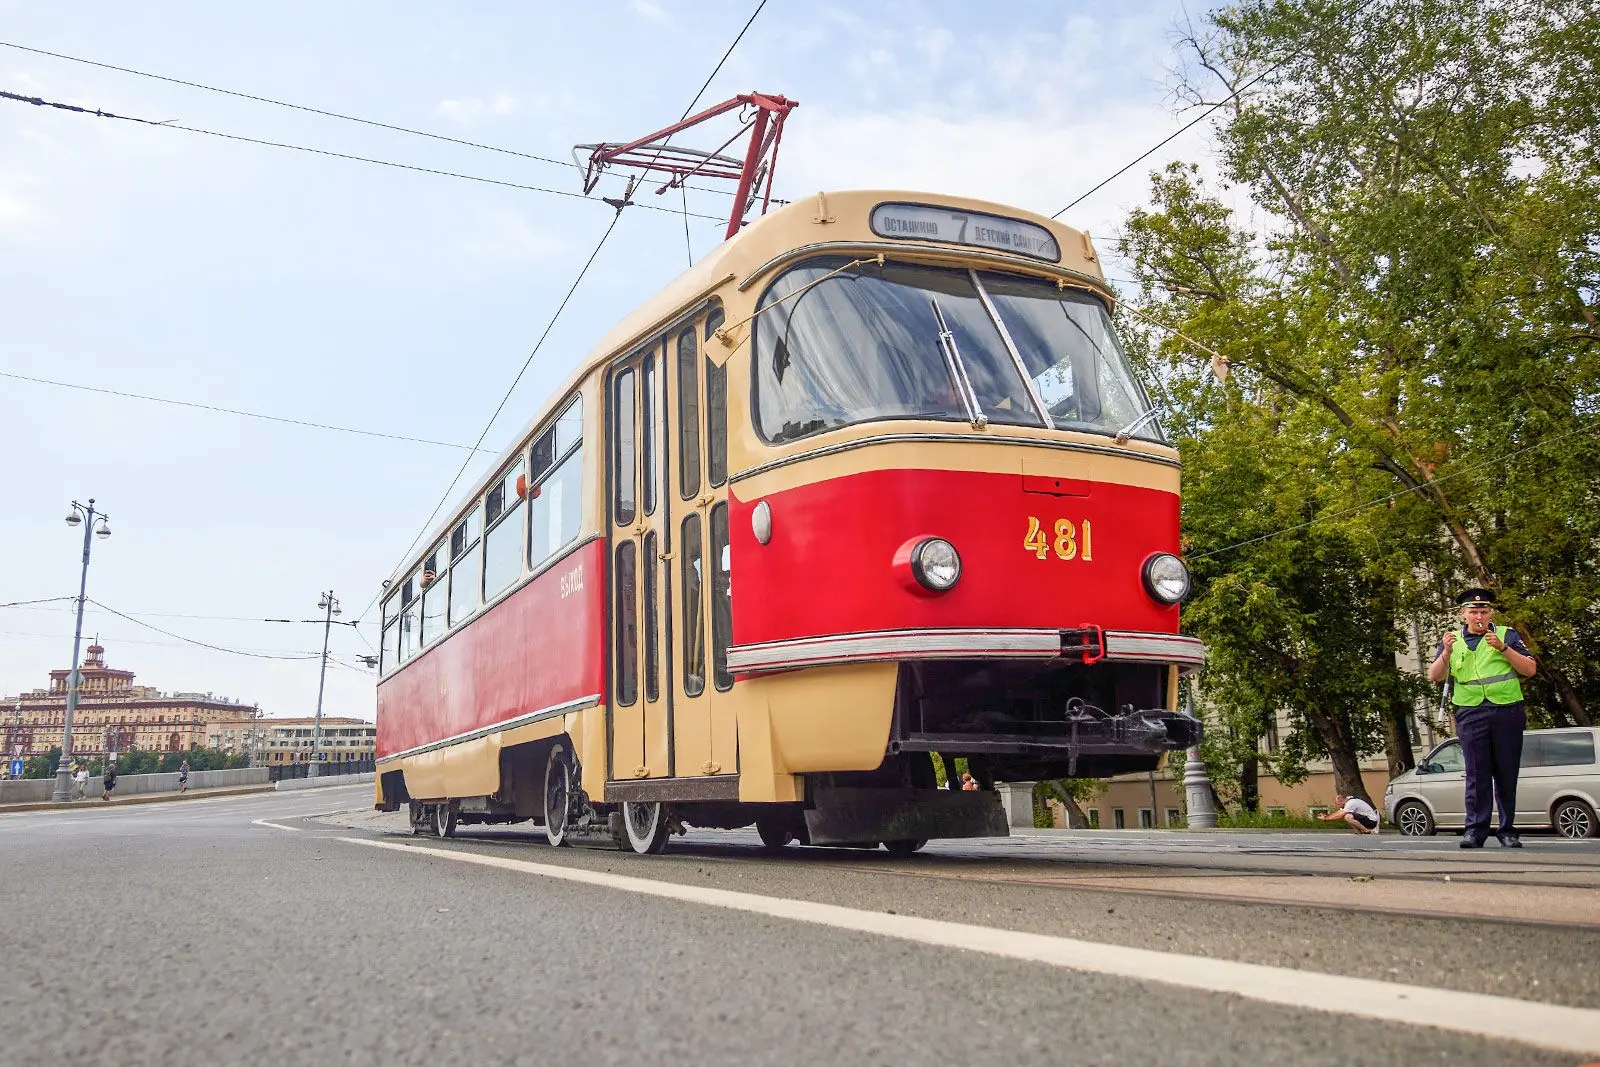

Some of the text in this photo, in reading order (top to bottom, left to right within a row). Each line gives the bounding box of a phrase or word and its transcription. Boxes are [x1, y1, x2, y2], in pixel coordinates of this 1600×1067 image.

[883, 215, 938, 235] ОСТАНКИНО
[951, 214, 969, 243] 7
[974, 225, 1011, 246] ДЕТСКИЙ
[1023, 515, 1092, 562] 481
[560, 564, 583, 599] ВЫХОД
